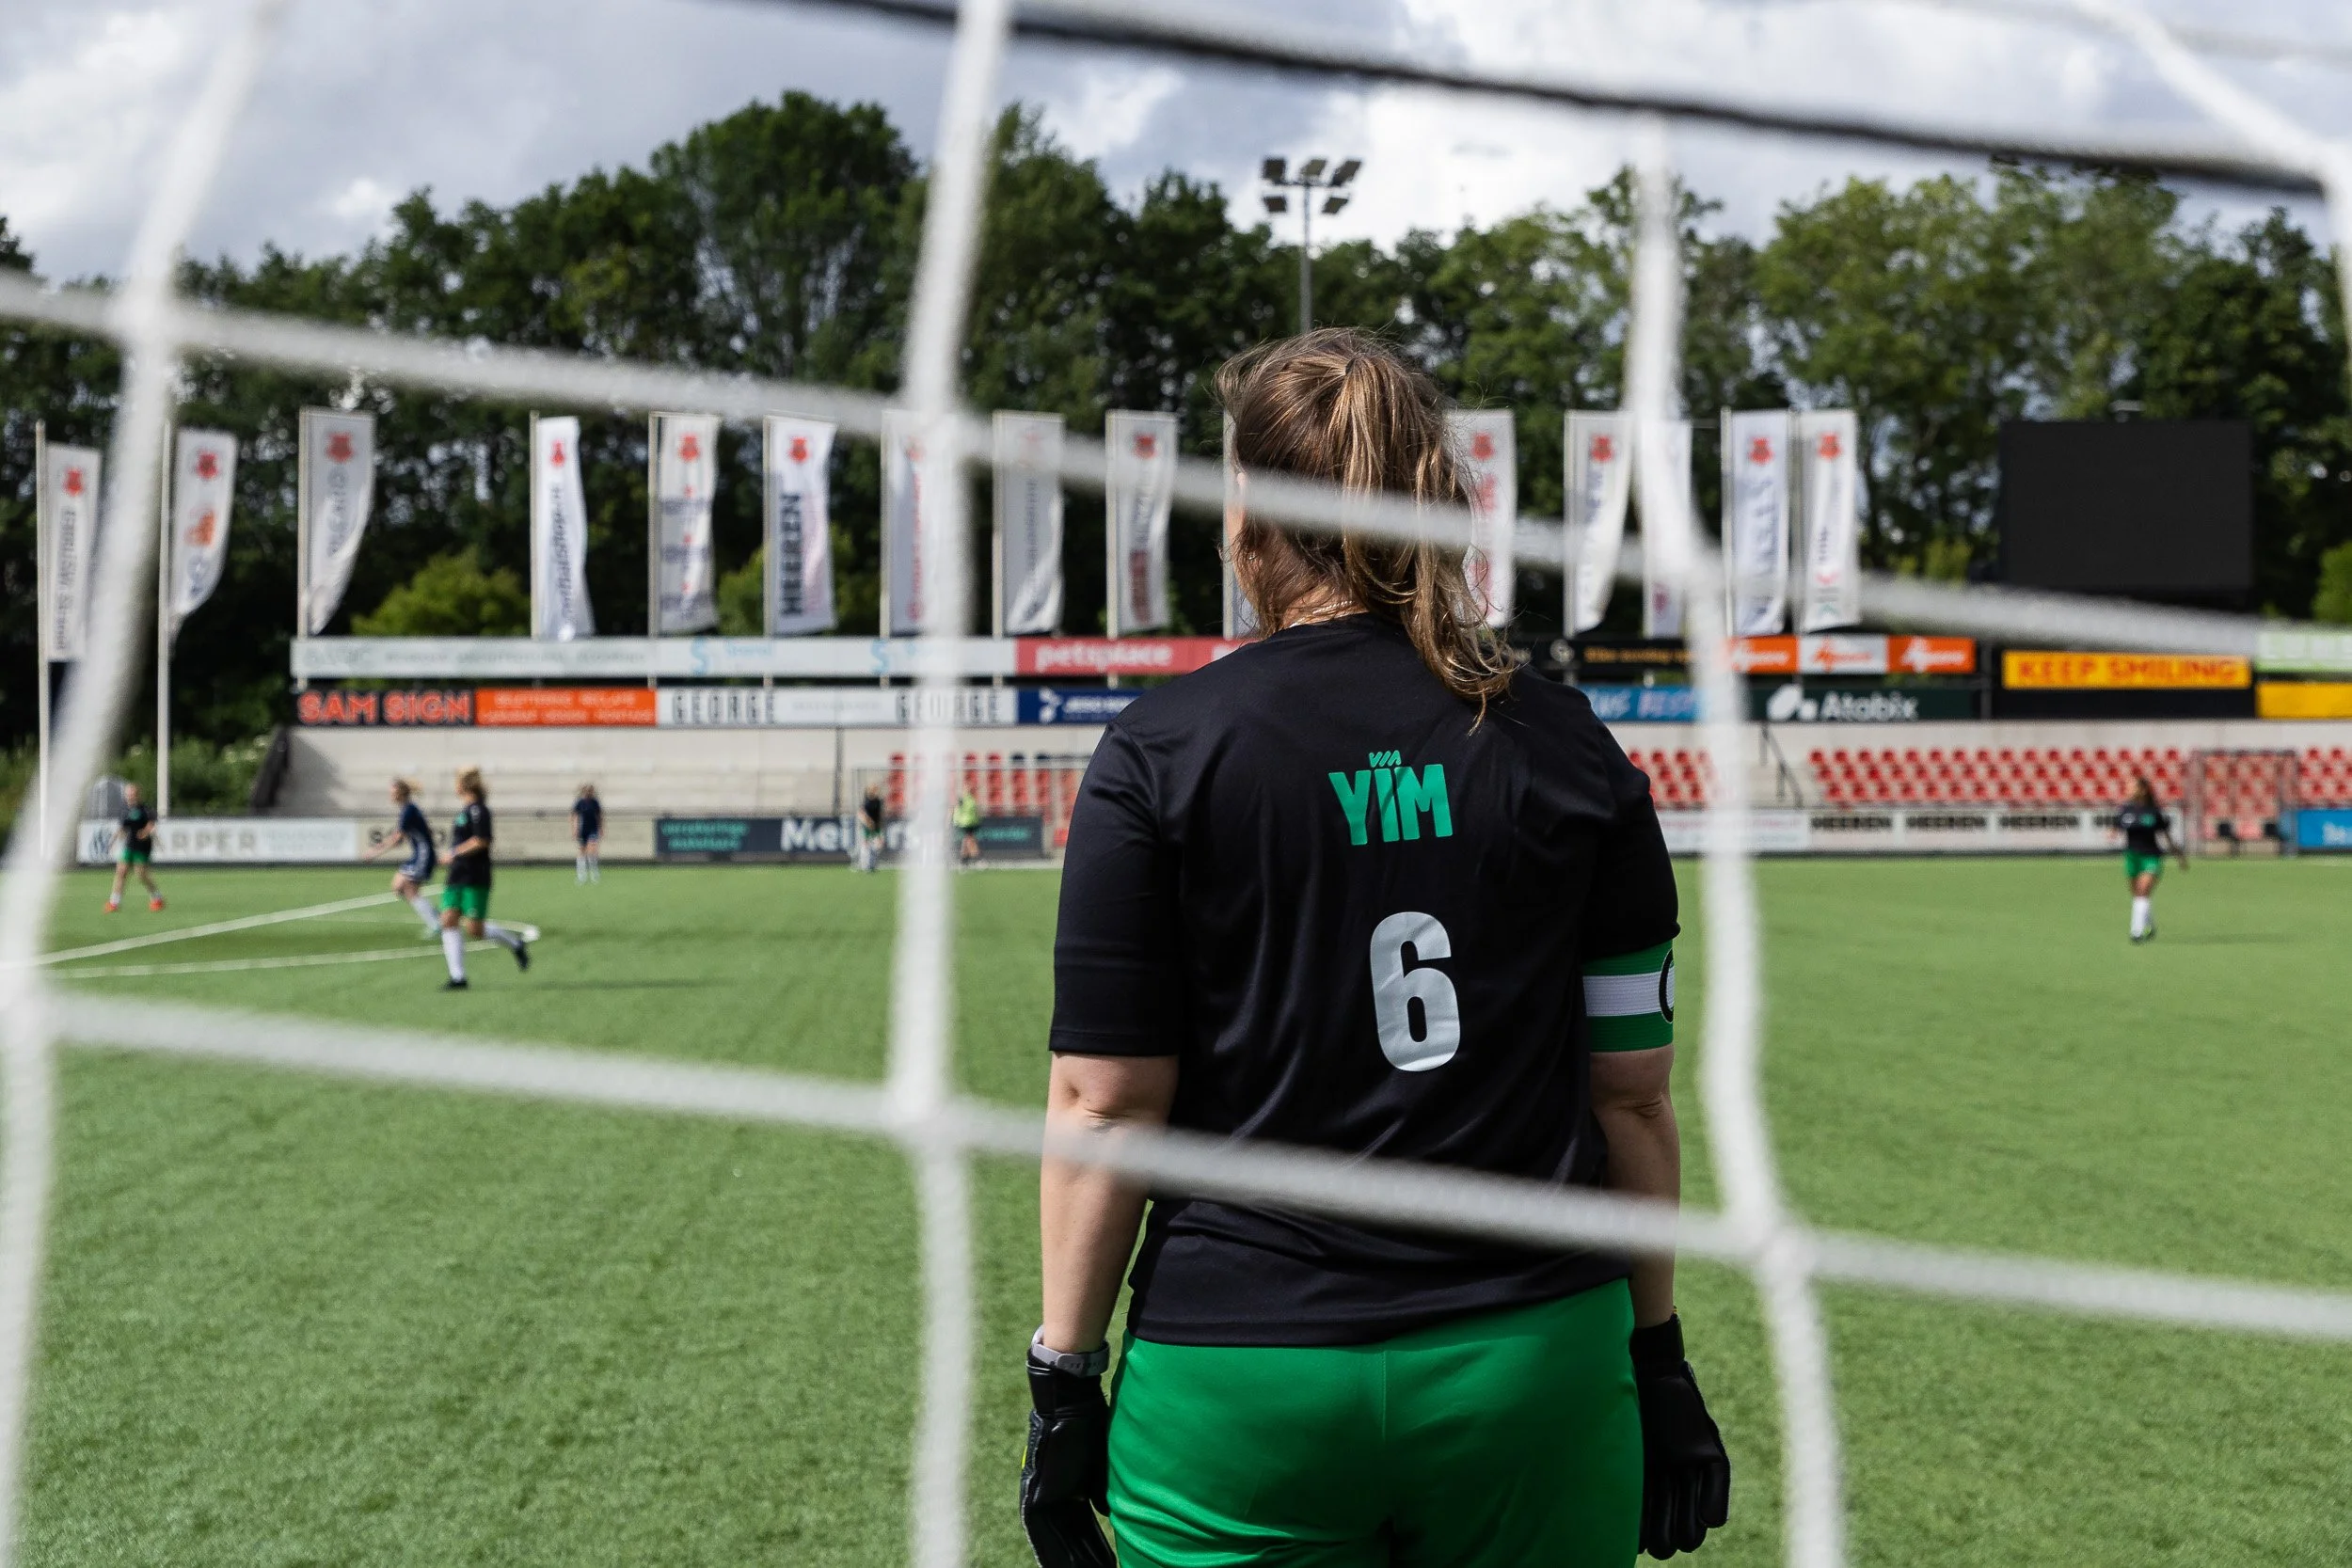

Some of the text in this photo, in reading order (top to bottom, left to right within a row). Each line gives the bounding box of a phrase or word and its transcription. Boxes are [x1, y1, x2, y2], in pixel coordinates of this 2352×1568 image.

[297, 689, 376, 725] SAM
[672, 692, 776, 724] GEORGE
[1370, 911, 1460, 1071] 6
